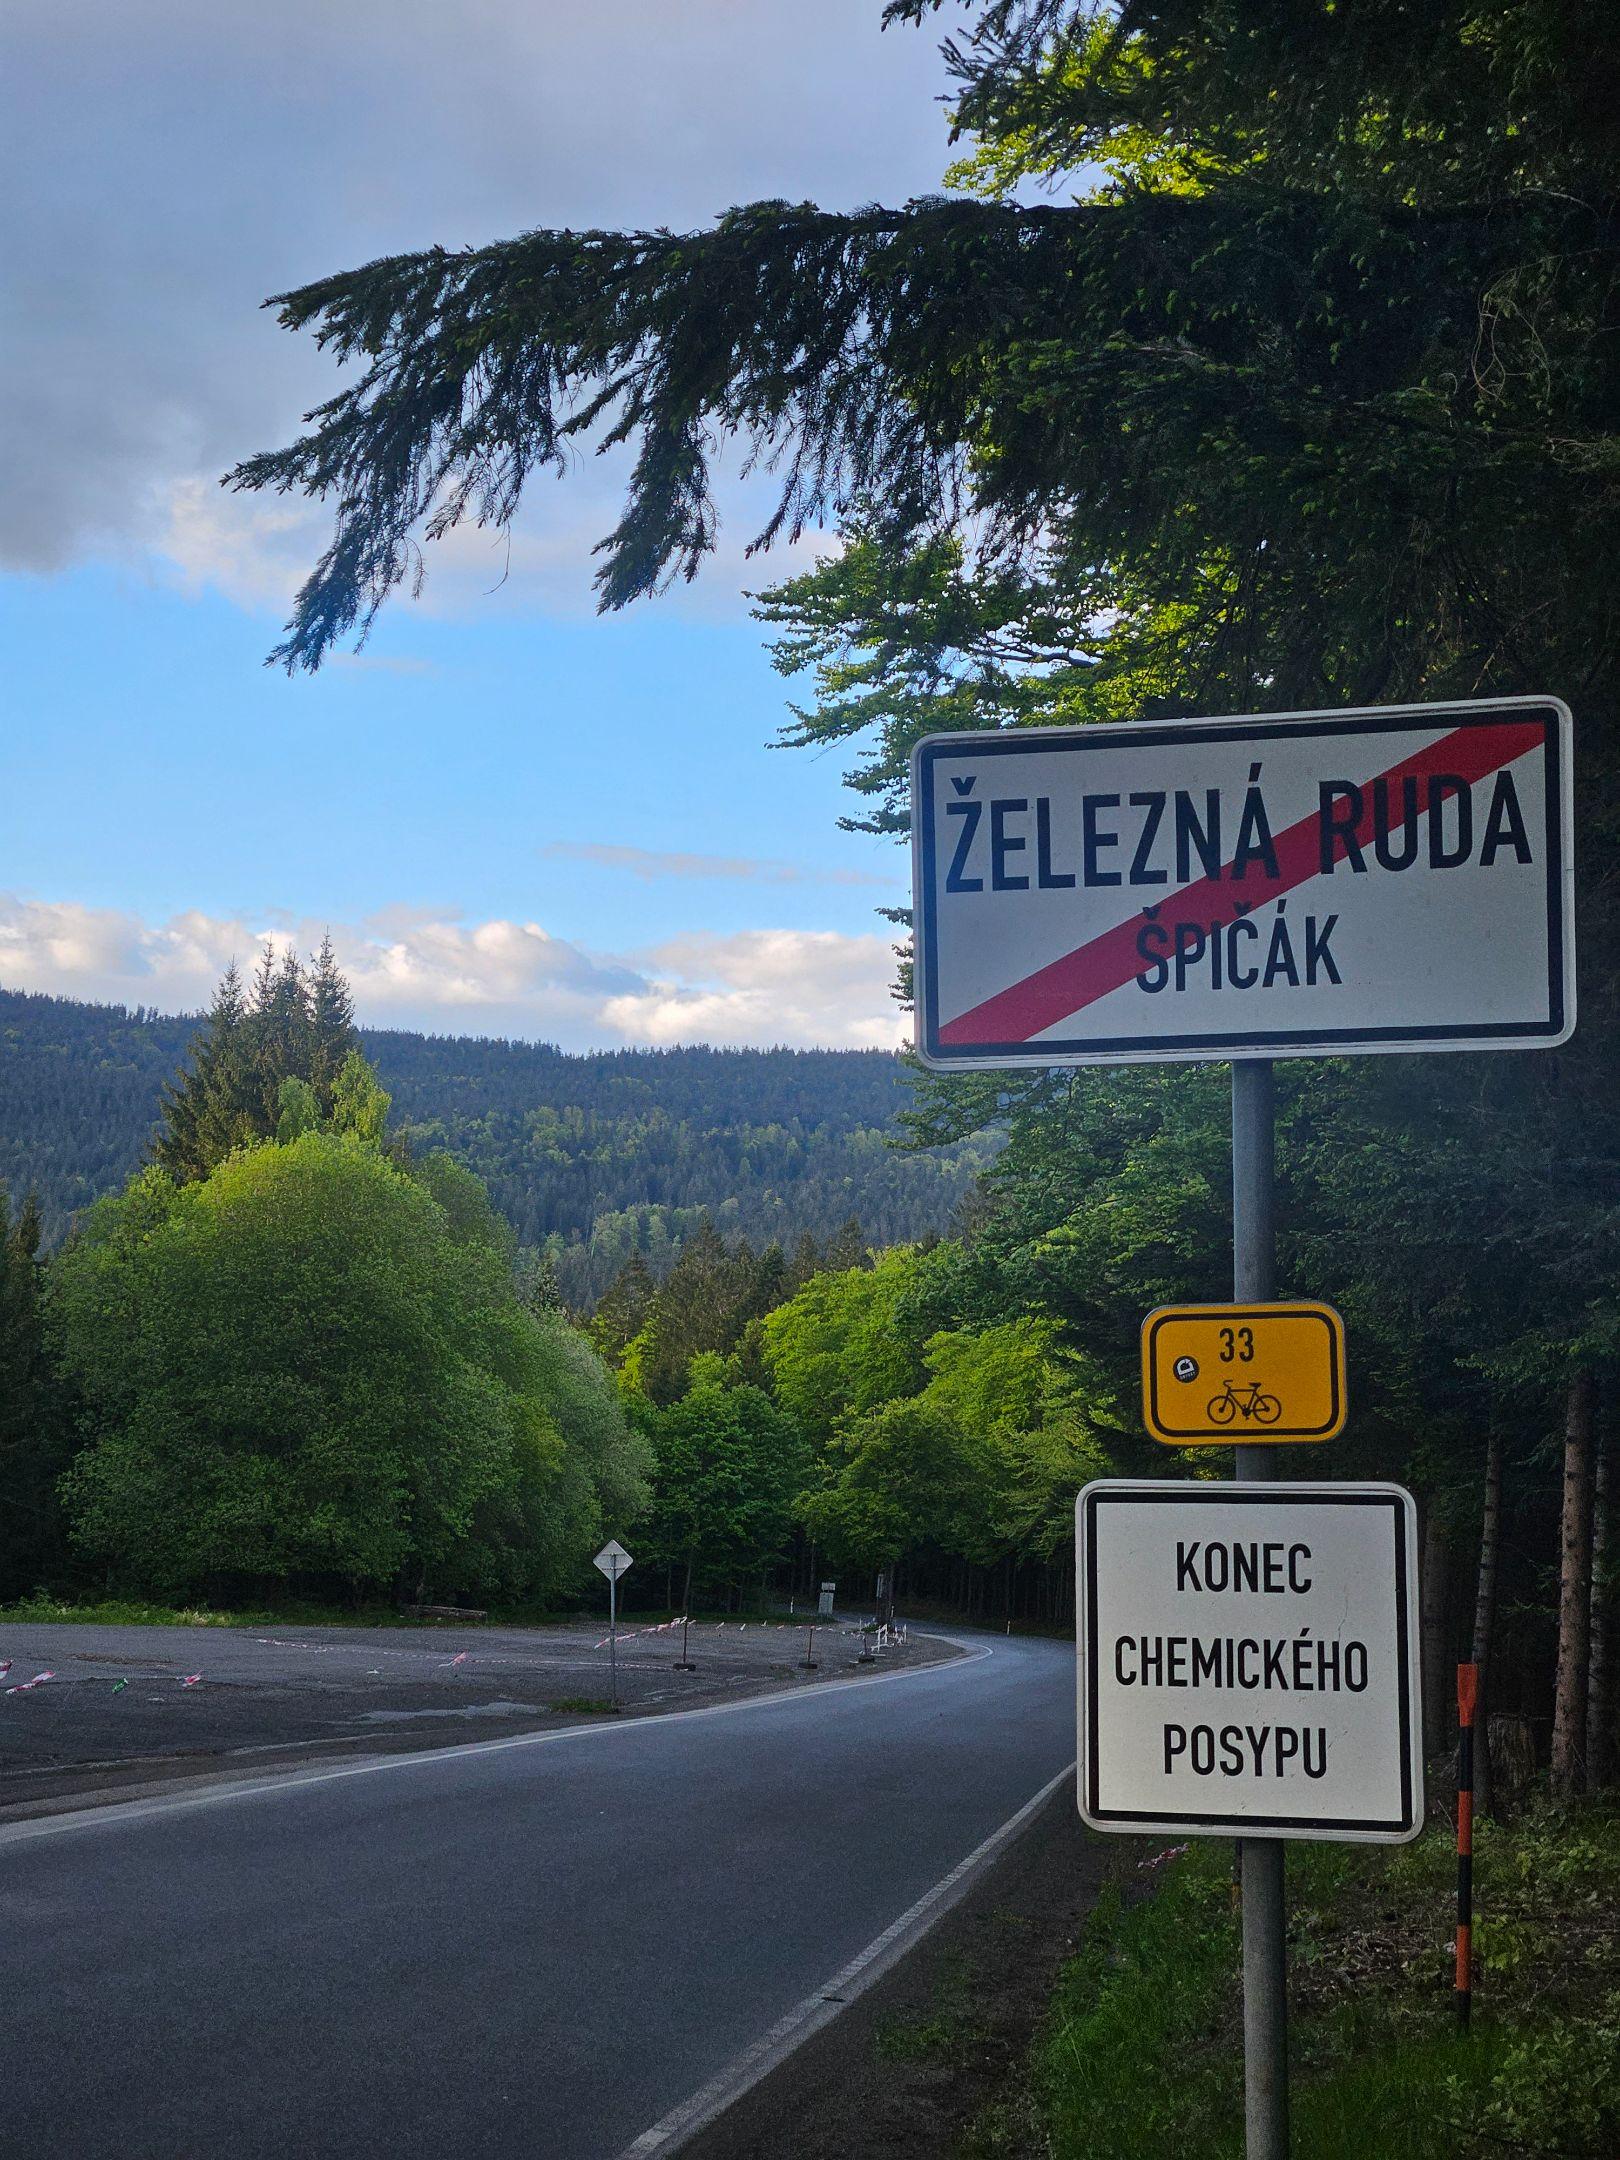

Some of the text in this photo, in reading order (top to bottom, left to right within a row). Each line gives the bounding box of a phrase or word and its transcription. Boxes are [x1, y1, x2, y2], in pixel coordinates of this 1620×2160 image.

[946, 763, 1533, 892] ŽELEZNÁ RUDA
[1136, 900, 1342, 994] ŠPIČÁK
[1219, 1327, 1255, 1363] 33
[1176, 1541, 1312, 1594] KONEC
[1114, 1628, 1369, 1693] CHEMICKÉHO
[1163, 1724, 1328, 1778] POSYPU
